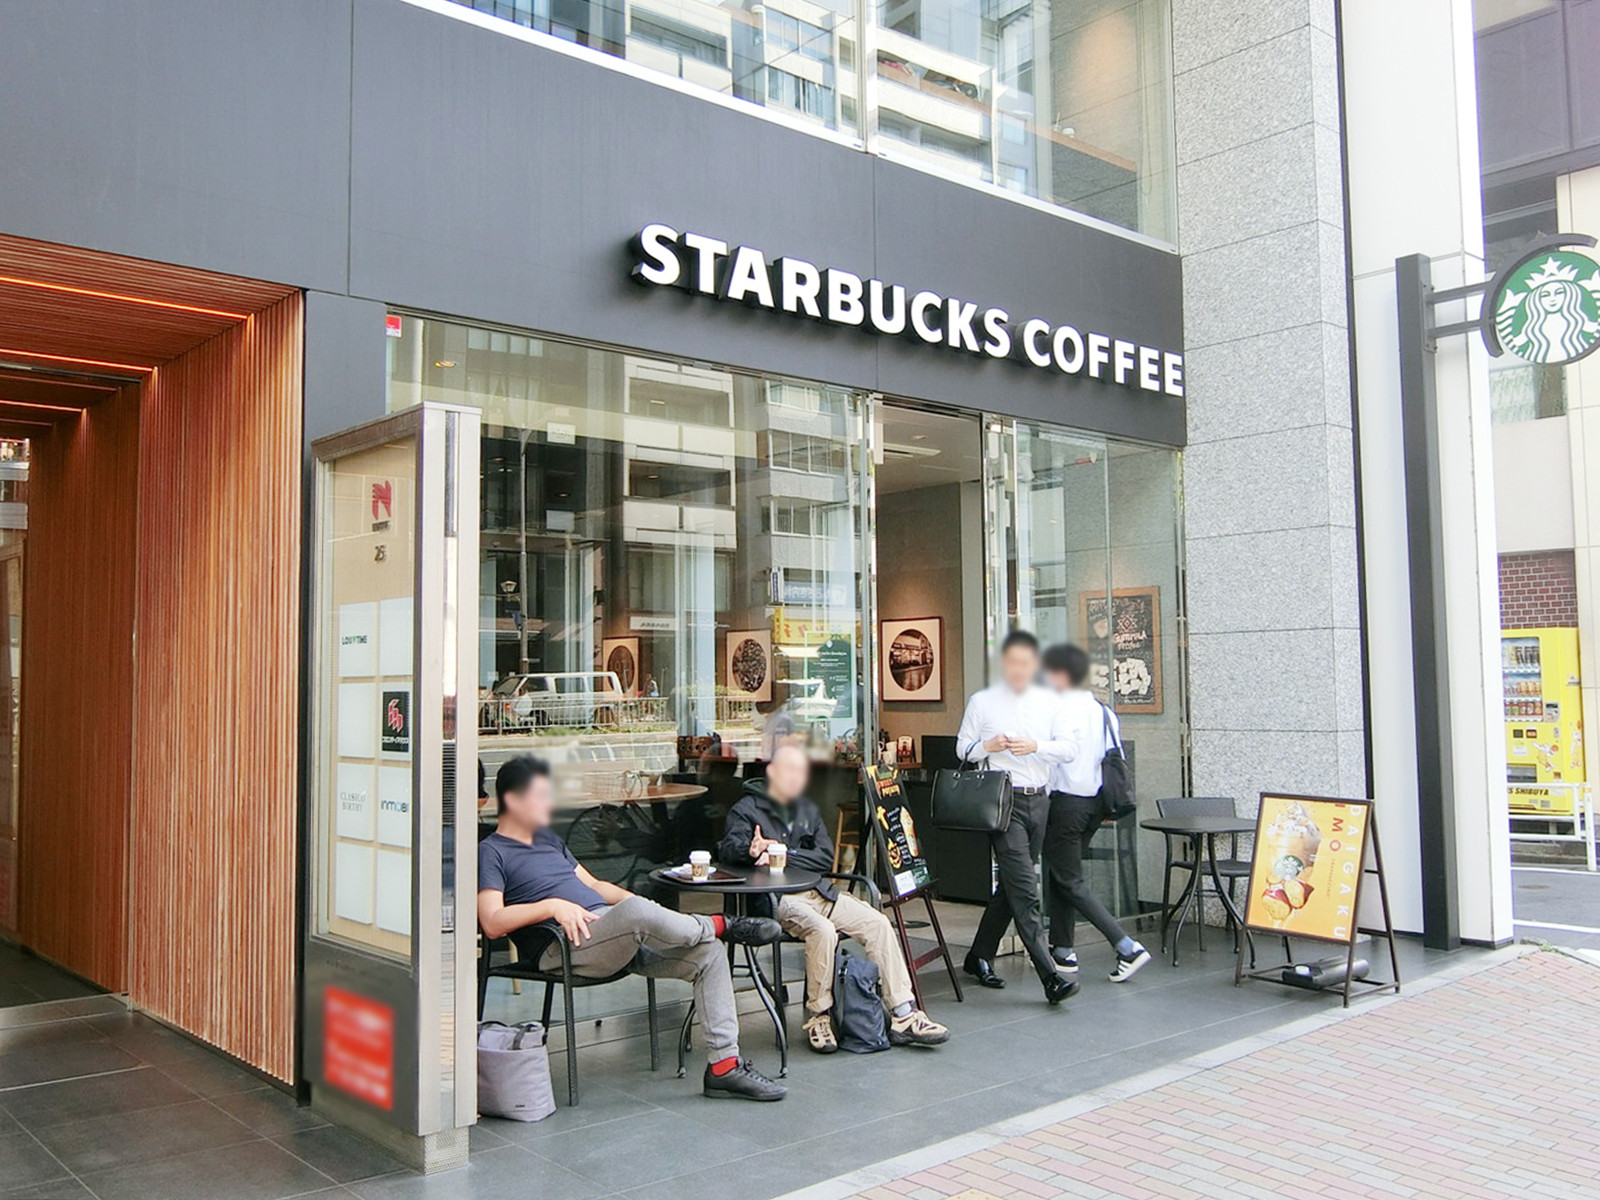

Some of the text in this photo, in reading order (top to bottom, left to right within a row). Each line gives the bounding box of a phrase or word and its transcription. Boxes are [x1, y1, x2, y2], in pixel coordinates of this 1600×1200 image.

[639, 222, 1184, 398] STARBUCKS COFFEE
[1515, 787, 1550, 796] SHIBUYA
[1333, 805, 1362, 938] DAIGAKU
